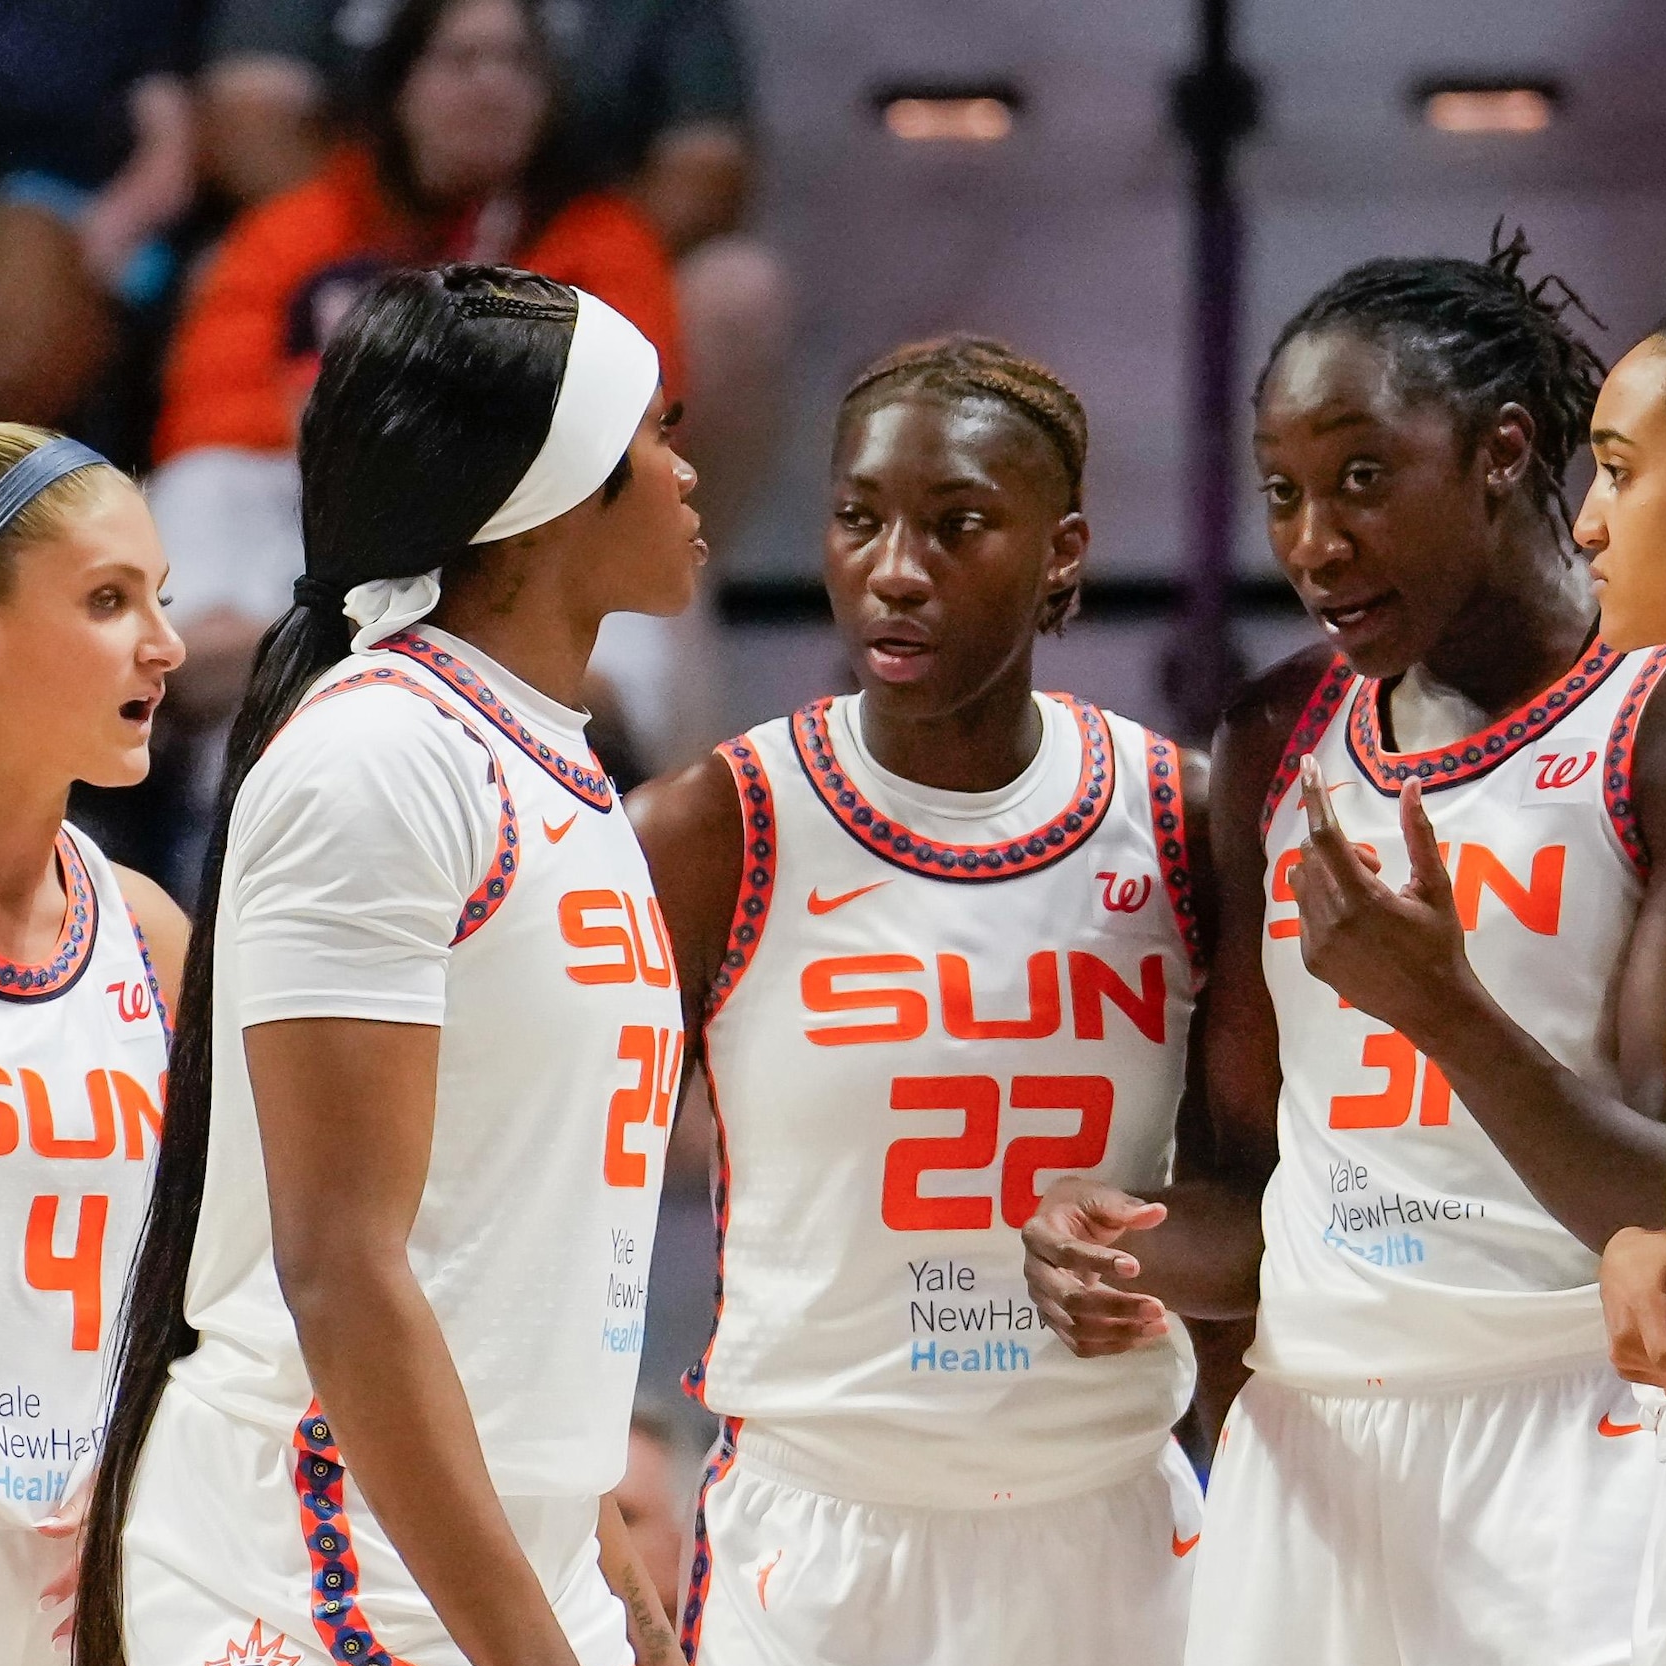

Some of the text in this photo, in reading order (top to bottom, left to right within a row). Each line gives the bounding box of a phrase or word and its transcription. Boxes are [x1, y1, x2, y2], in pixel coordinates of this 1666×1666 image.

[1269, 841, 1565, 936] SN
[558, 889, 681, 990] SU
[800, 950, 1166, 1046] SUN
[881, 1075, 1114, 1231] 22
[1329, 1159, 1368, 1194] Yale
[1329, 1193, 1484, 1232] NewHaven
[24, 1195, 109, 1351] 4
[908, 1260, 975, 1292] Yale
[910, 1297, 1050, 1333] NewHa
[911, 1339, 1030, 1372] Health
